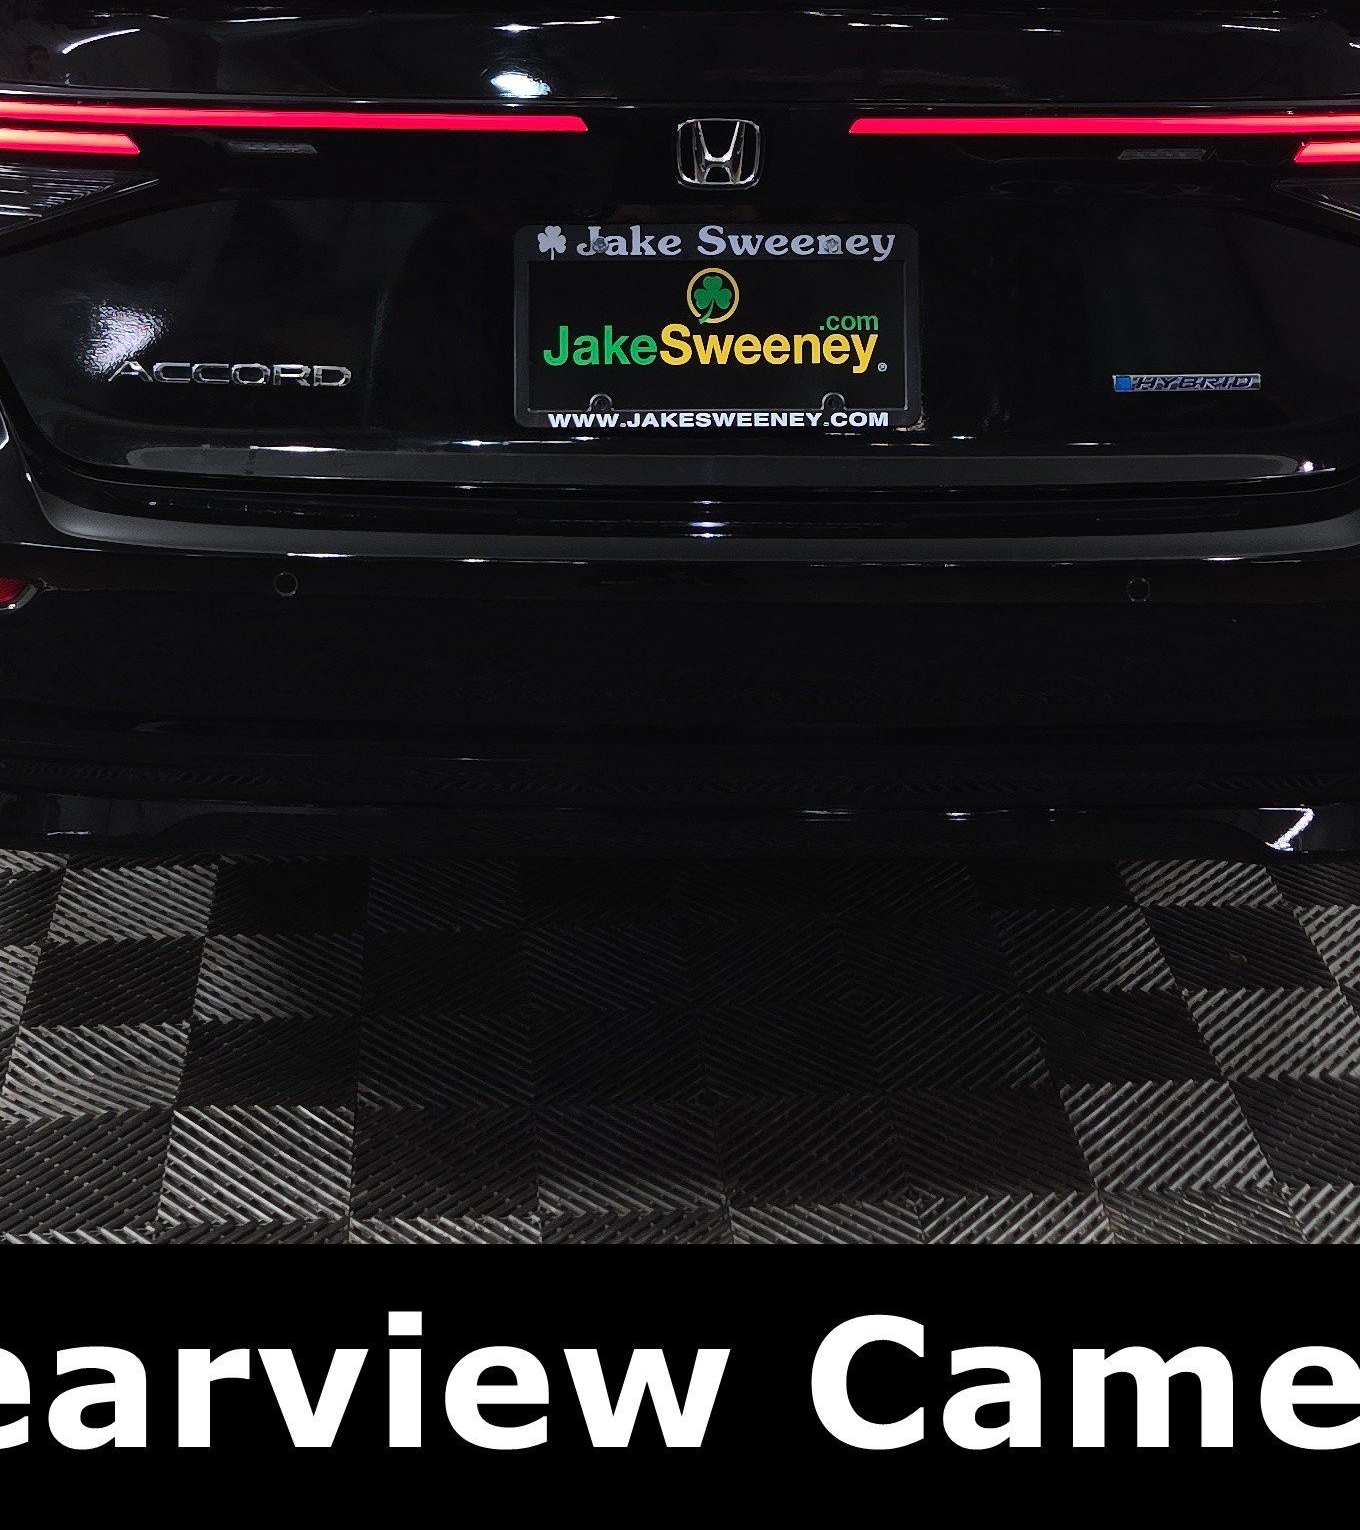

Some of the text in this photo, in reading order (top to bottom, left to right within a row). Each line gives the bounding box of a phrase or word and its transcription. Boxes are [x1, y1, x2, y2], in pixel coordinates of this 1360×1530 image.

[576, 224, 896, 262] Jake Sweeney
[107, 360, 353, 387] ACCORD
[1134, 375, 1253, 390] HYBRID
[547, 412, 889, 428] WWW.JAKESWEENEY.COM
